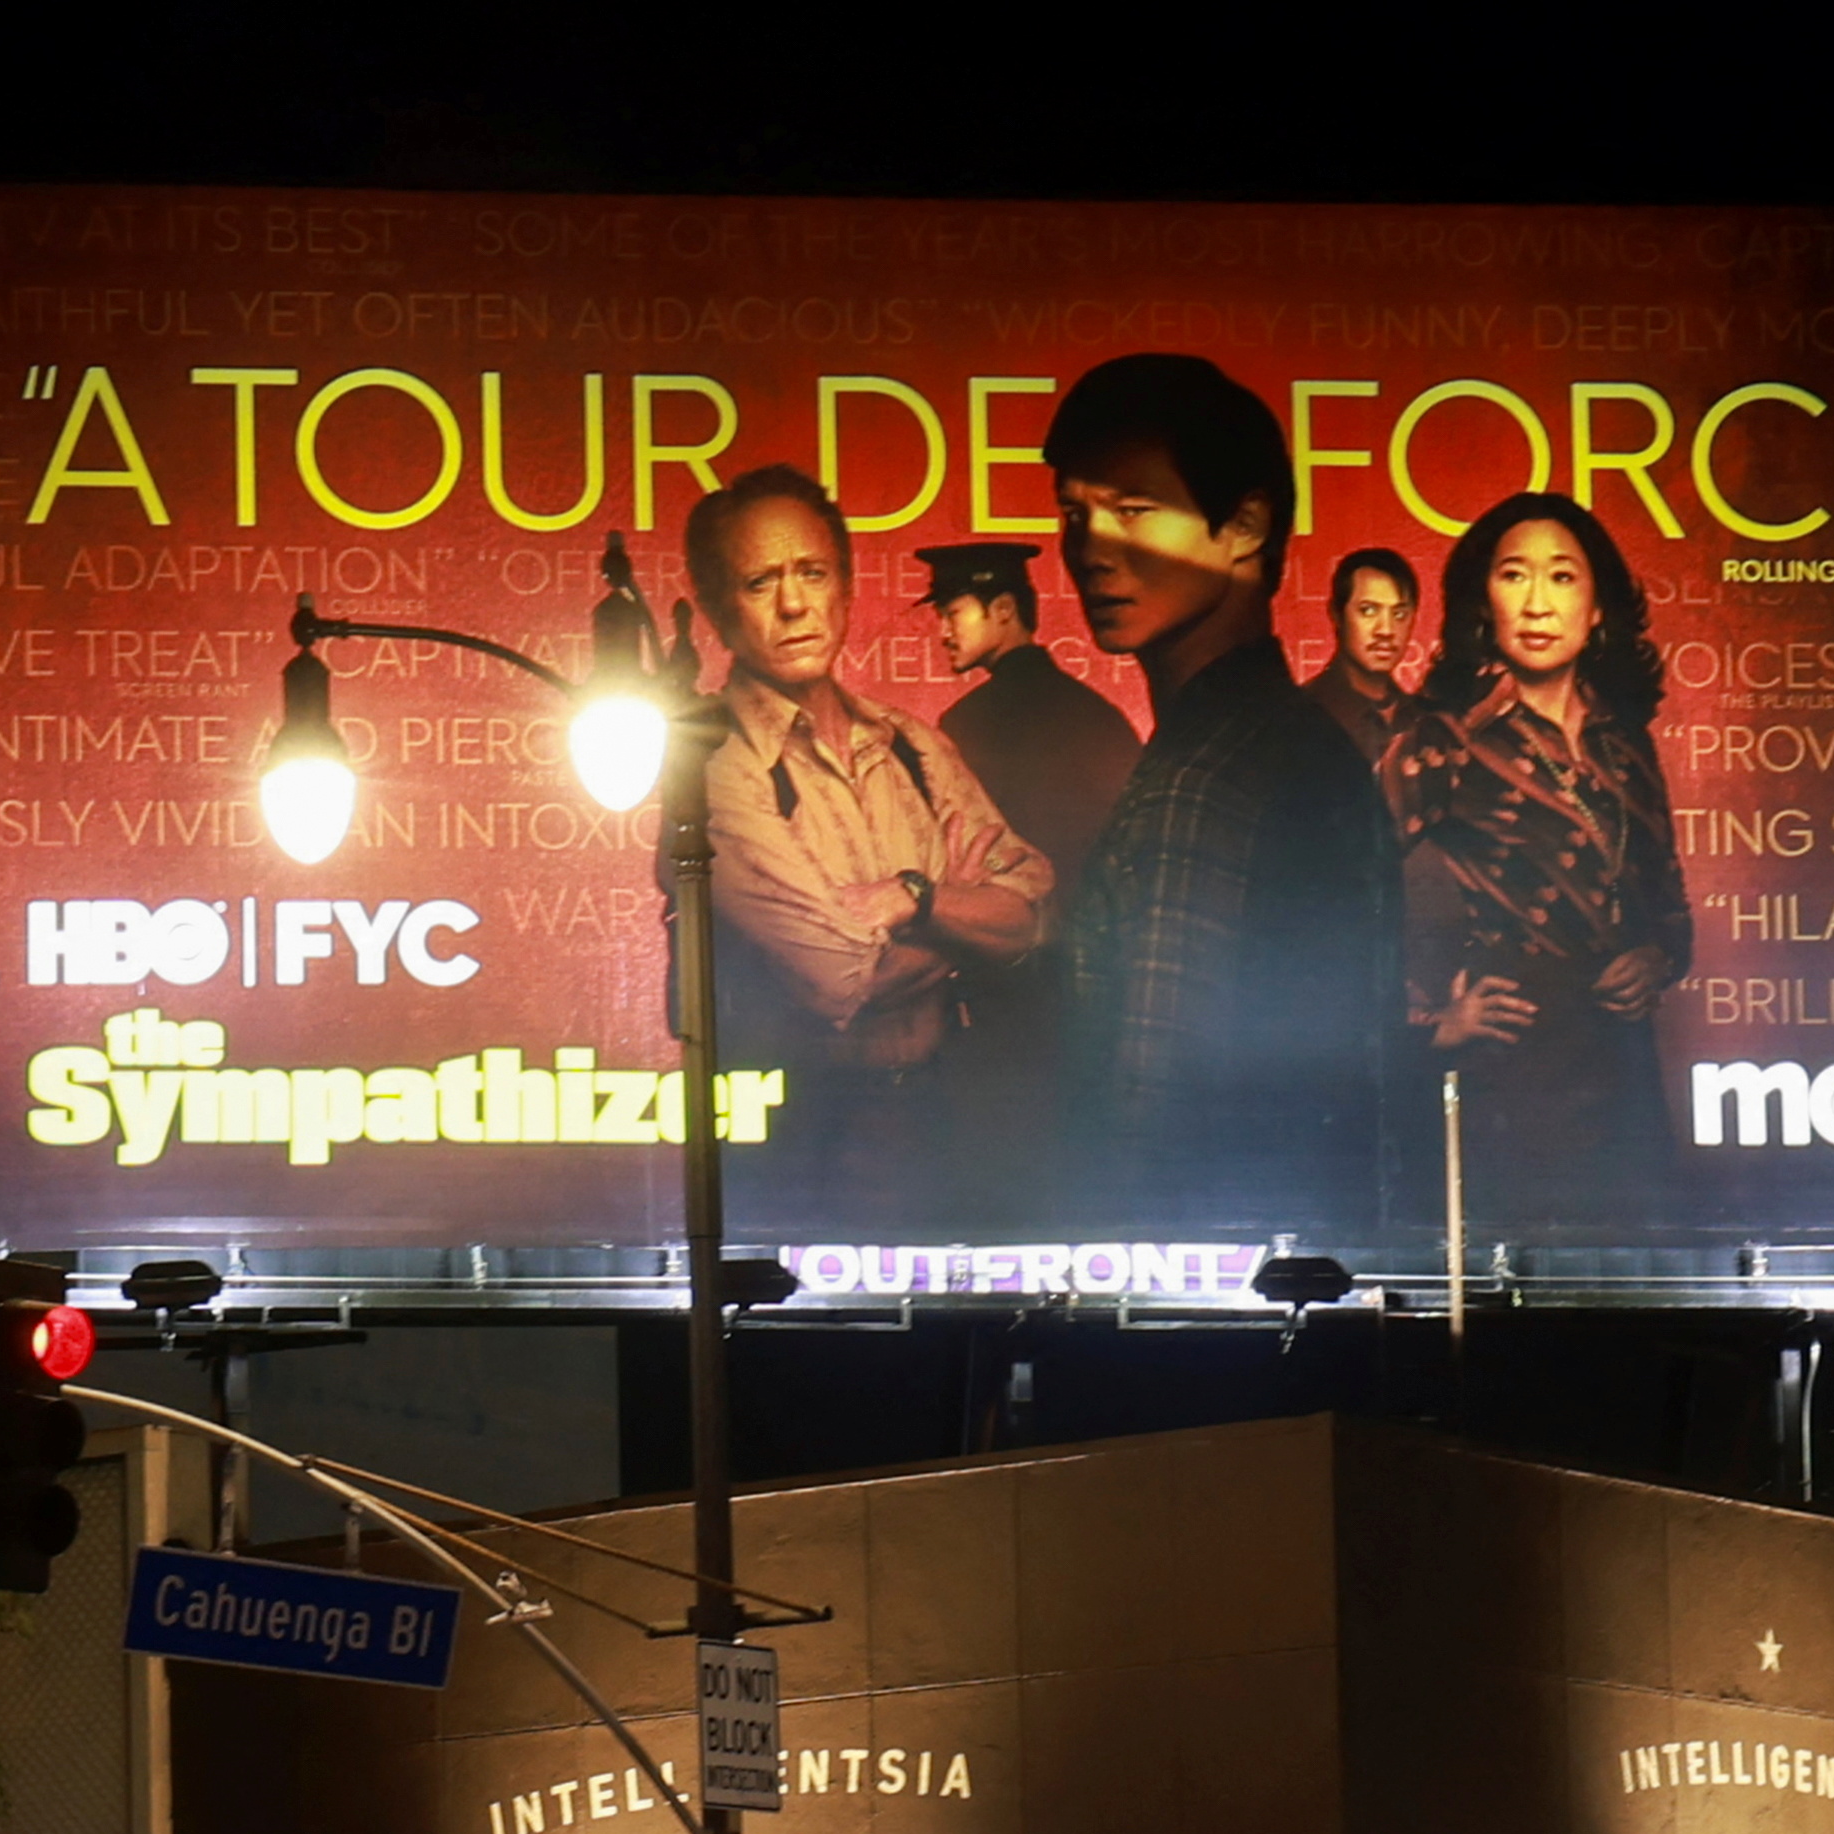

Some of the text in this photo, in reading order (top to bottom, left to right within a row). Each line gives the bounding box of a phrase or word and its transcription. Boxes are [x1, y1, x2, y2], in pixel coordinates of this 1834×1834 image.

[188, 366, 739, 533] TOUR
[817, 374, 1059, 535] DE
[26, 898, 482, 989] HBO FYC
[103, 1007, 227, 1069] the
[153, 1573, 372, 1664] Cahuenga
[703, 1662, 774, 1705] DO NOT
[705, 1716, 773, 1757] BLOCK
